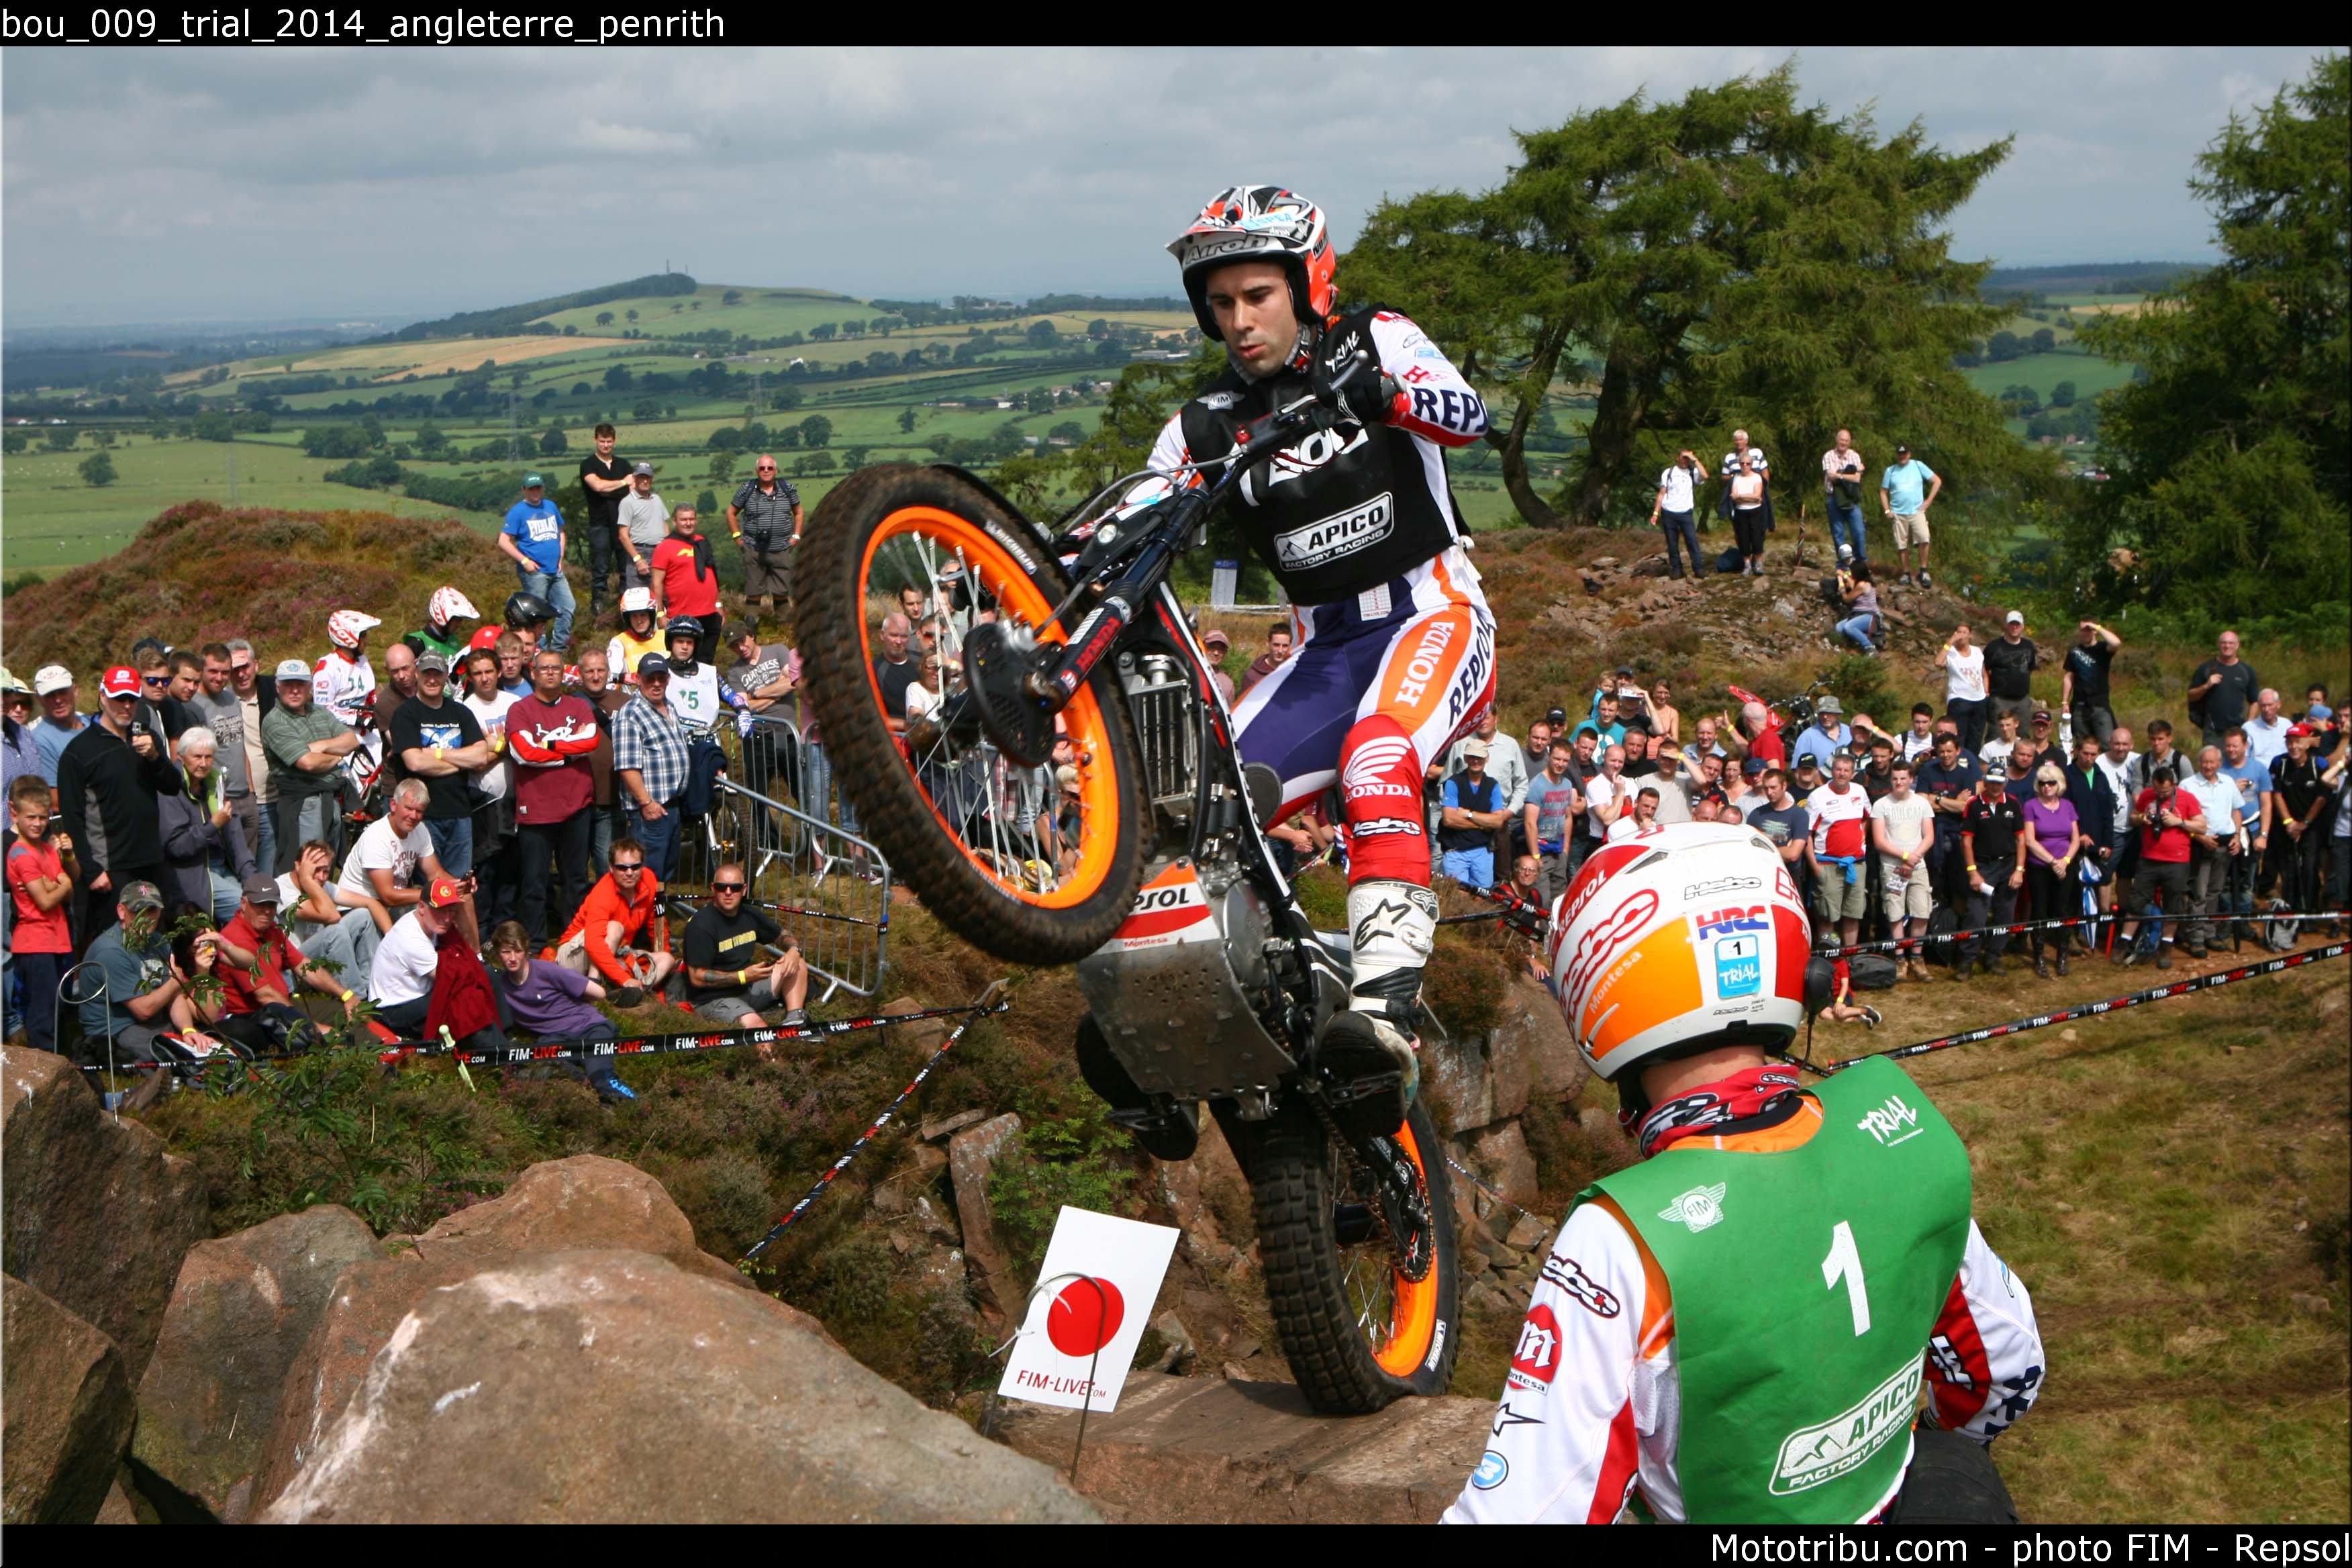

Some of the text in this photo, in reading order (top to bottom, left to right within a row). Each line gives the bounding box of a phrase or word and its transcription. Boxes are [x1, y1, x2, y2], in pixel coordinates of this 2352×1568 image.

[1285, 529, 1384, 569] FACTORY RACING
[1309, 506, 1384, 551] APICO
[740, 658, 781, 687] GUINNESS
[1393, 621, 1455, 708] HONDA
[1559, 869, 1608, 936] REPSOL
[1683, 877, 1762, 901] Hebo
[1696, 905, 1770, 940] HRC
[1732, 941, 1742, 956] 1
[1588, 950, 1644, 1015] Montesa
[1857, 1095, 1917, 1144] TRIAL
[1686, 1199, 1712, 1217] FIM
[1540, 1251, 1620, 1319] ebo
[1821, 1220, 1871, 1337] 1
[1508, 1371, 1545, 1392] ontesa
[1847, 1367, 1920, 1448] APICO
[1789, 1404, 1912, 1488] FACTORY RACING
